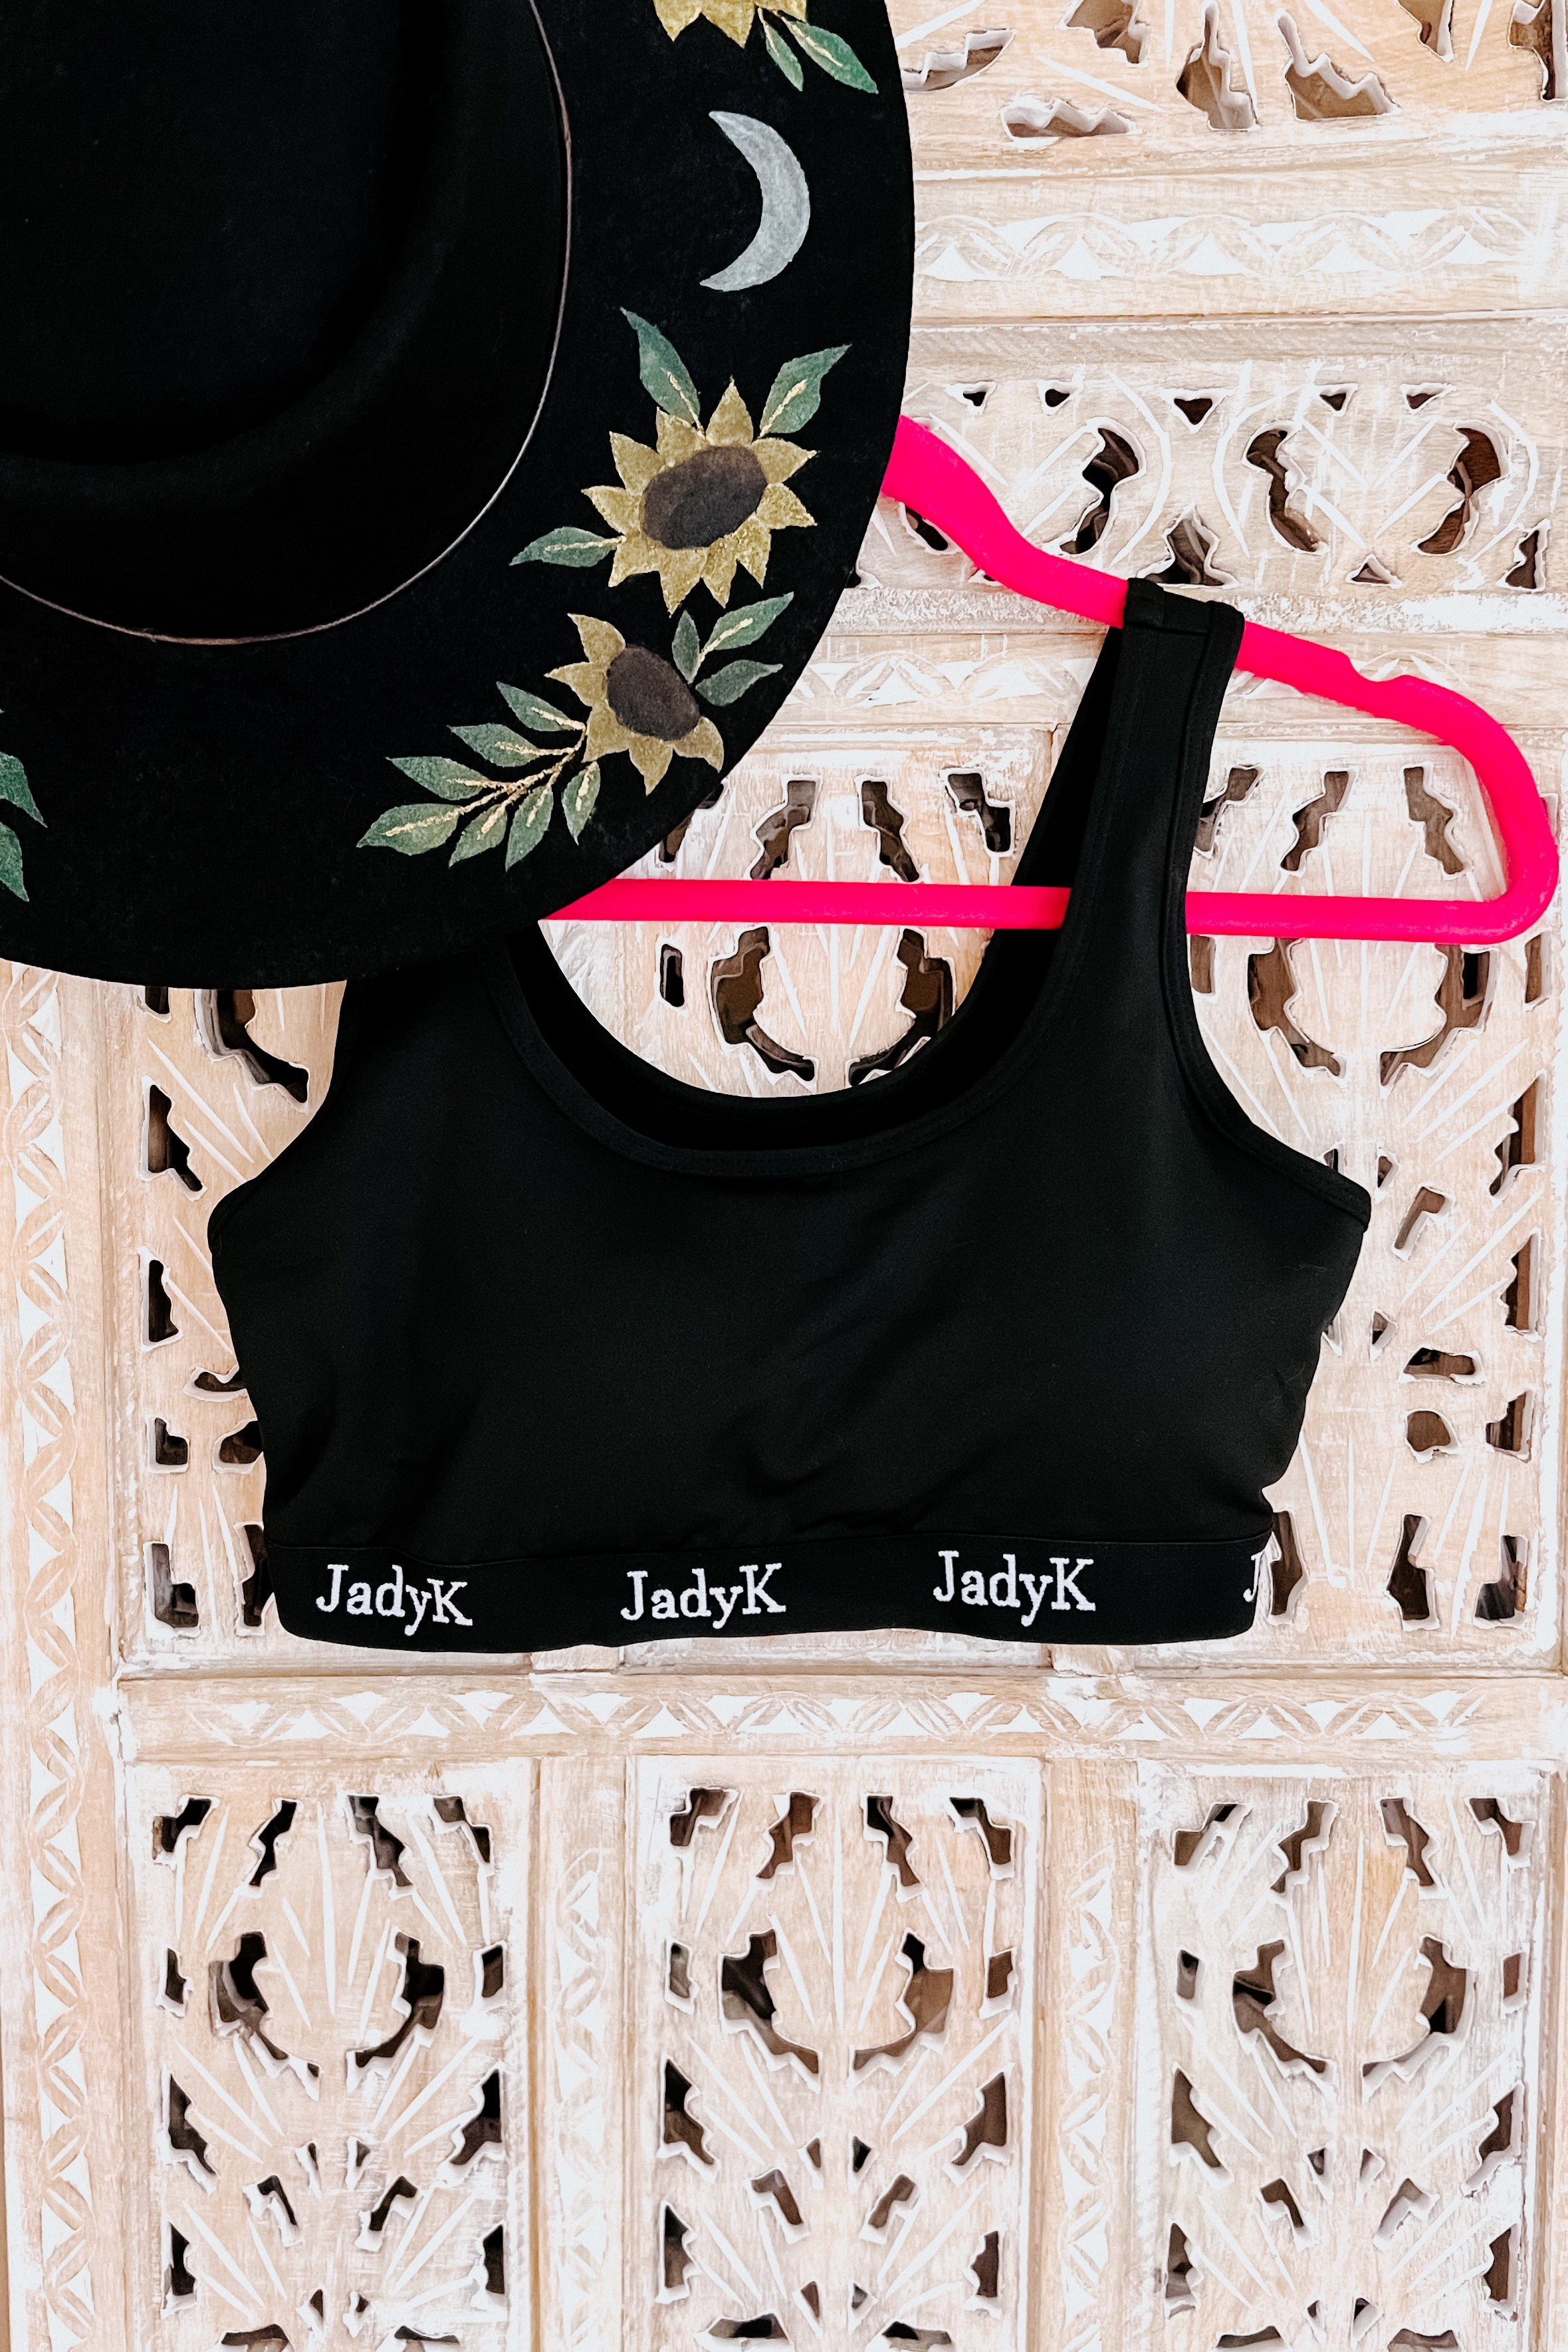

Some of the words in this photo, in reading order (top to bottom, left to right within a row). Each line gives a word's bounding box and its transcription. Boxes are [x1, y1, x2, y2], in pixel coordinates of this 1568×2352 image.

[315, 1564, 473, 1637] JadyK
[620, 1562, 787, 1629] JadyK
[933, 1550, 1096, 1627] JadyK
